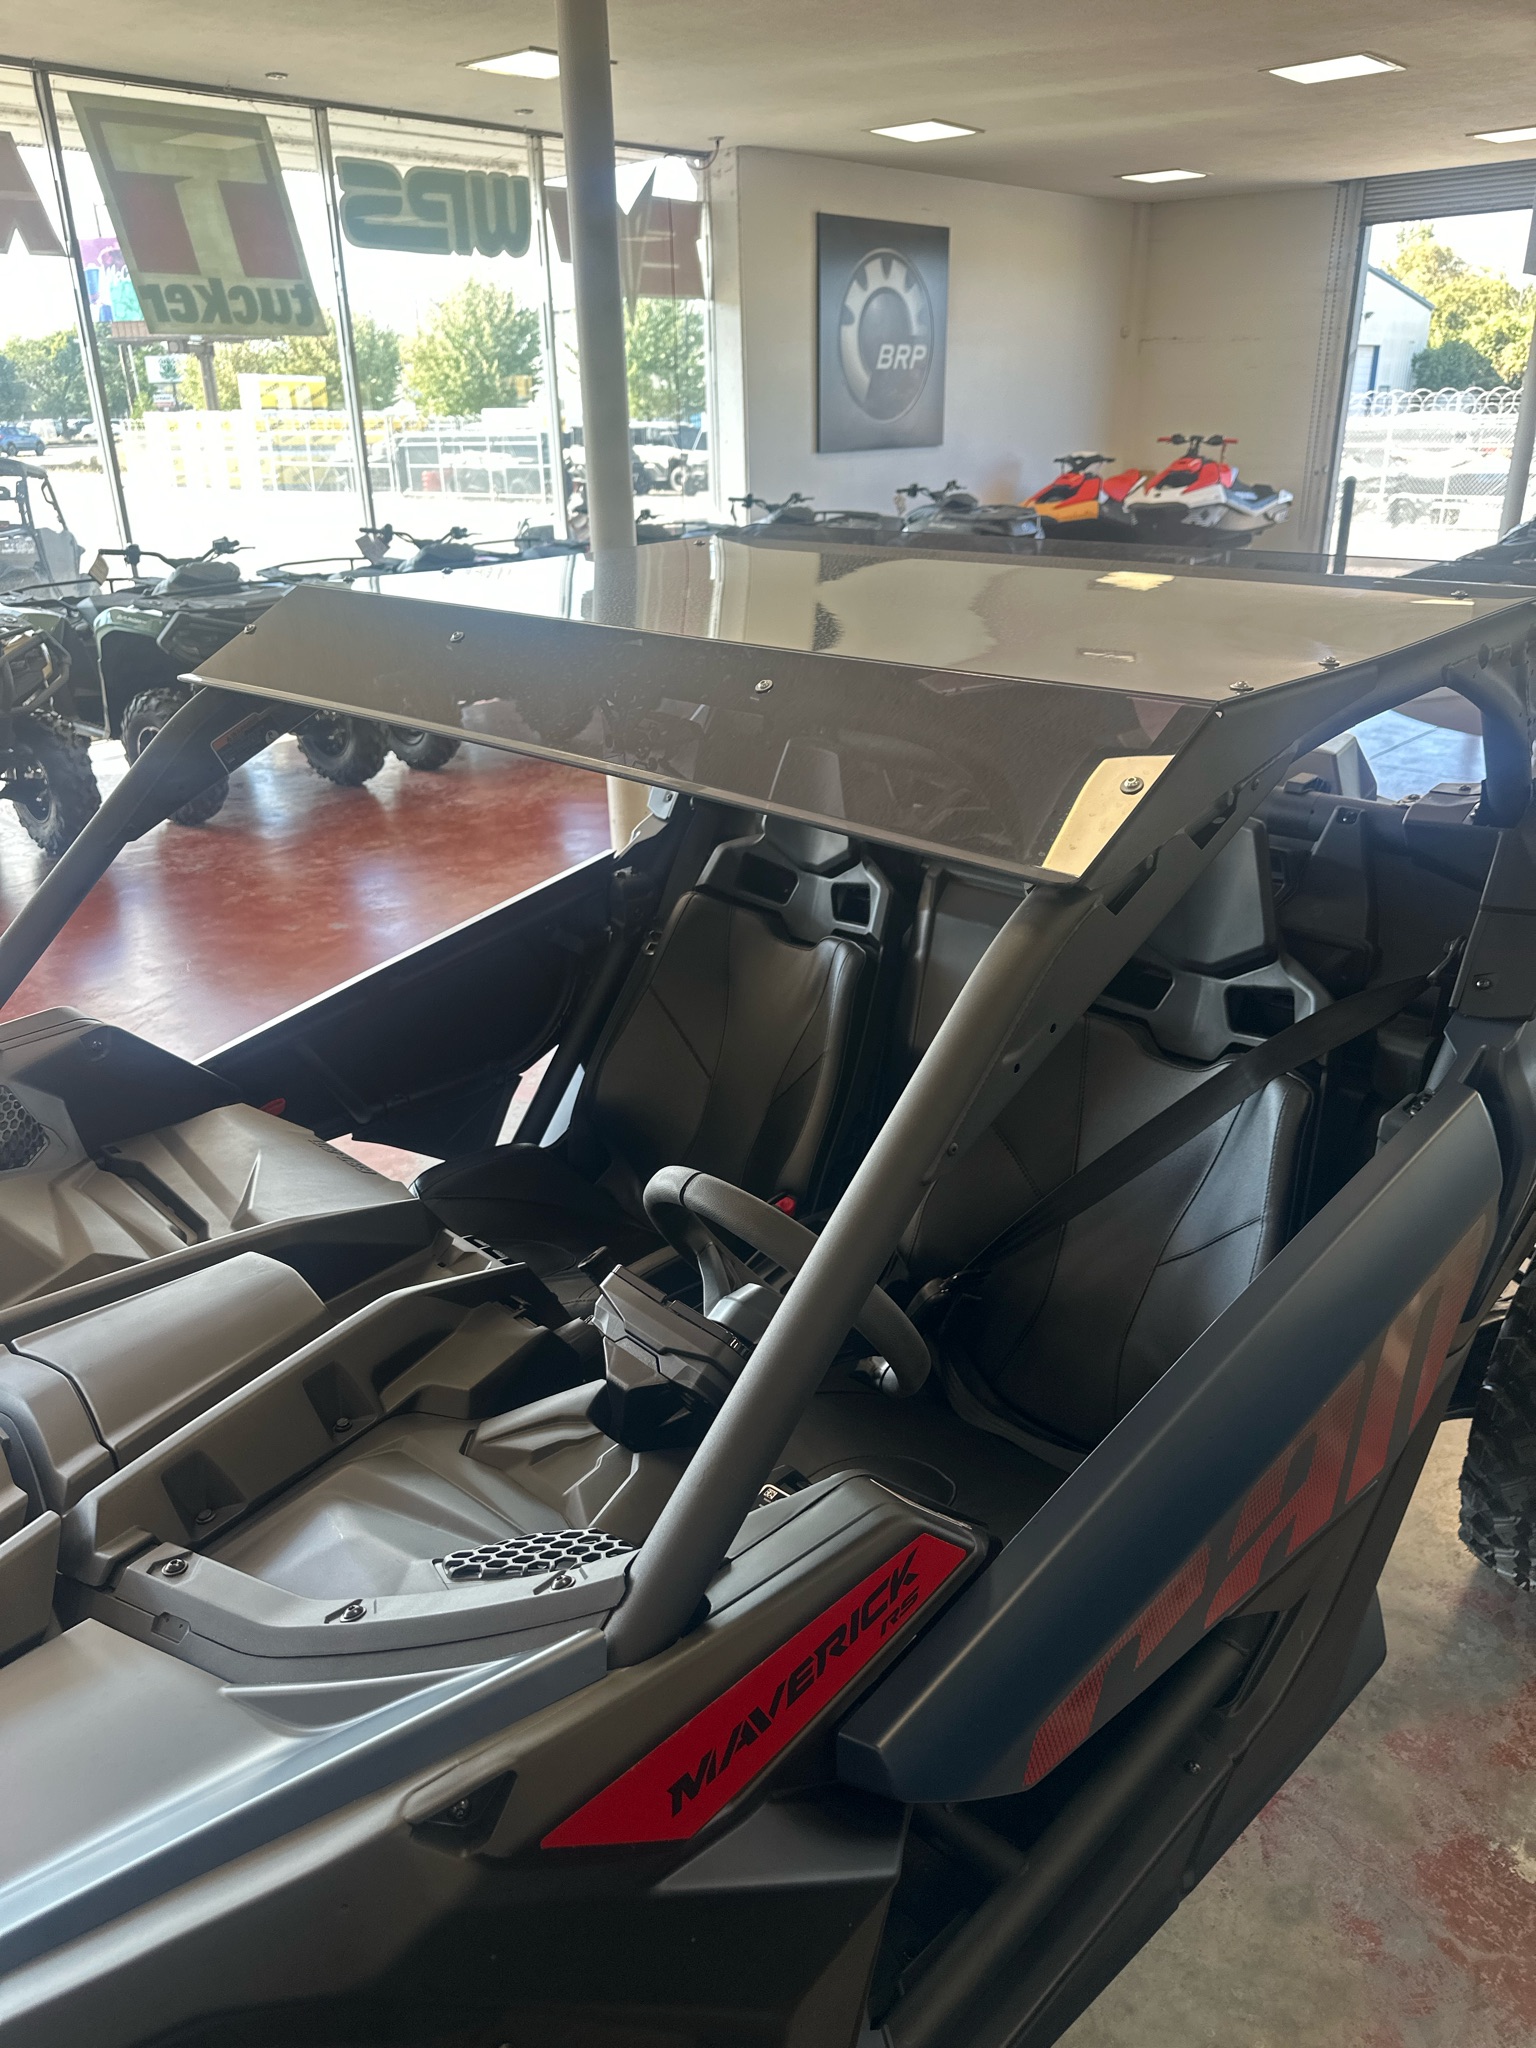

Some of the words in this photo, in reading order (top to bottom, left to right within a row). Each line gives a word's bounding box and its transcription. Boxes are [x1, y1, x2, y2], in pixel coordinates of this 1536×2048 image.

[876, 344, 928, 370] BRP
[879, 1585, 920, 1638] RS
[667, 1545, 919, 1818] MAVERICK
